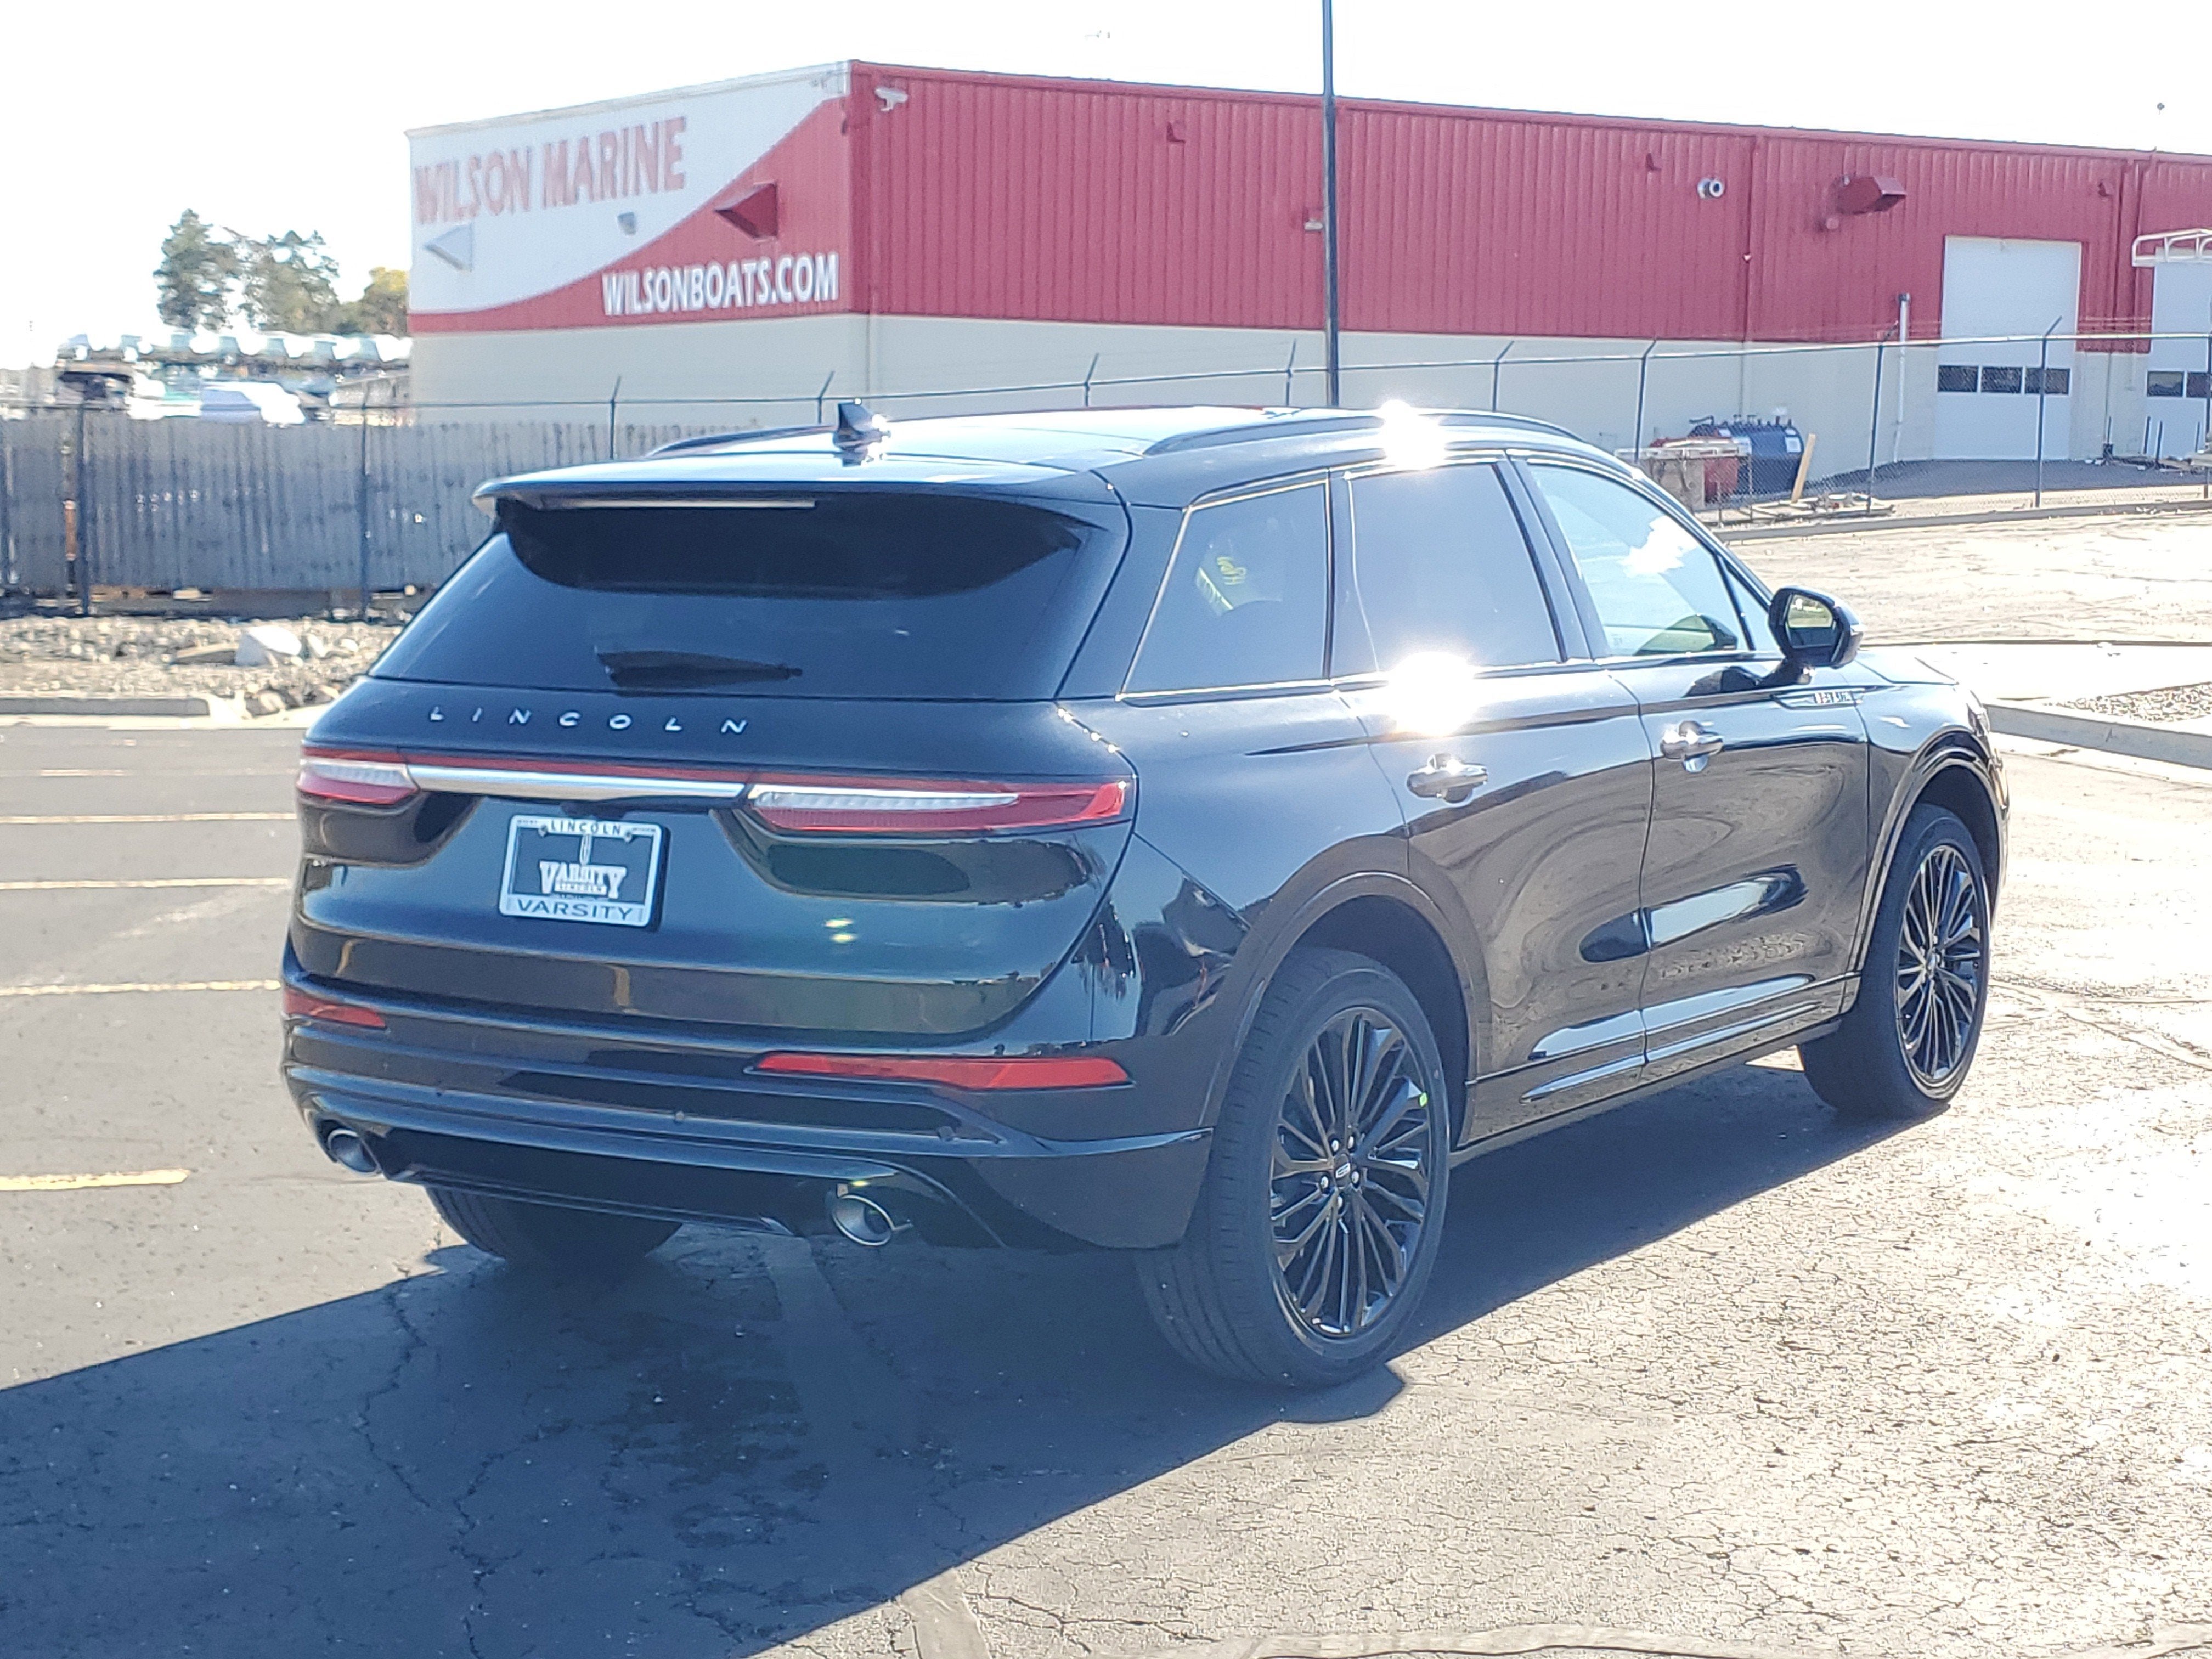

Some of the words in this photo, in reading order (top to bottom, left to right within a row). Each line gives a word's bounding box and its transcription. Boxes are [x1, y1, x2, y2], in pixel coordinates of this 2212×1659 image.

[415, 147, 532, 225] WILSON
[541, 116, 686, 210] MARINE
[602, 251, 840, 316] WILSONBOATS.COM
[430, 706, 748, 734] LINCOLN
[550, 819, 622, 836] LINCOLN
[517, 898, 633, 921] VARSITY
